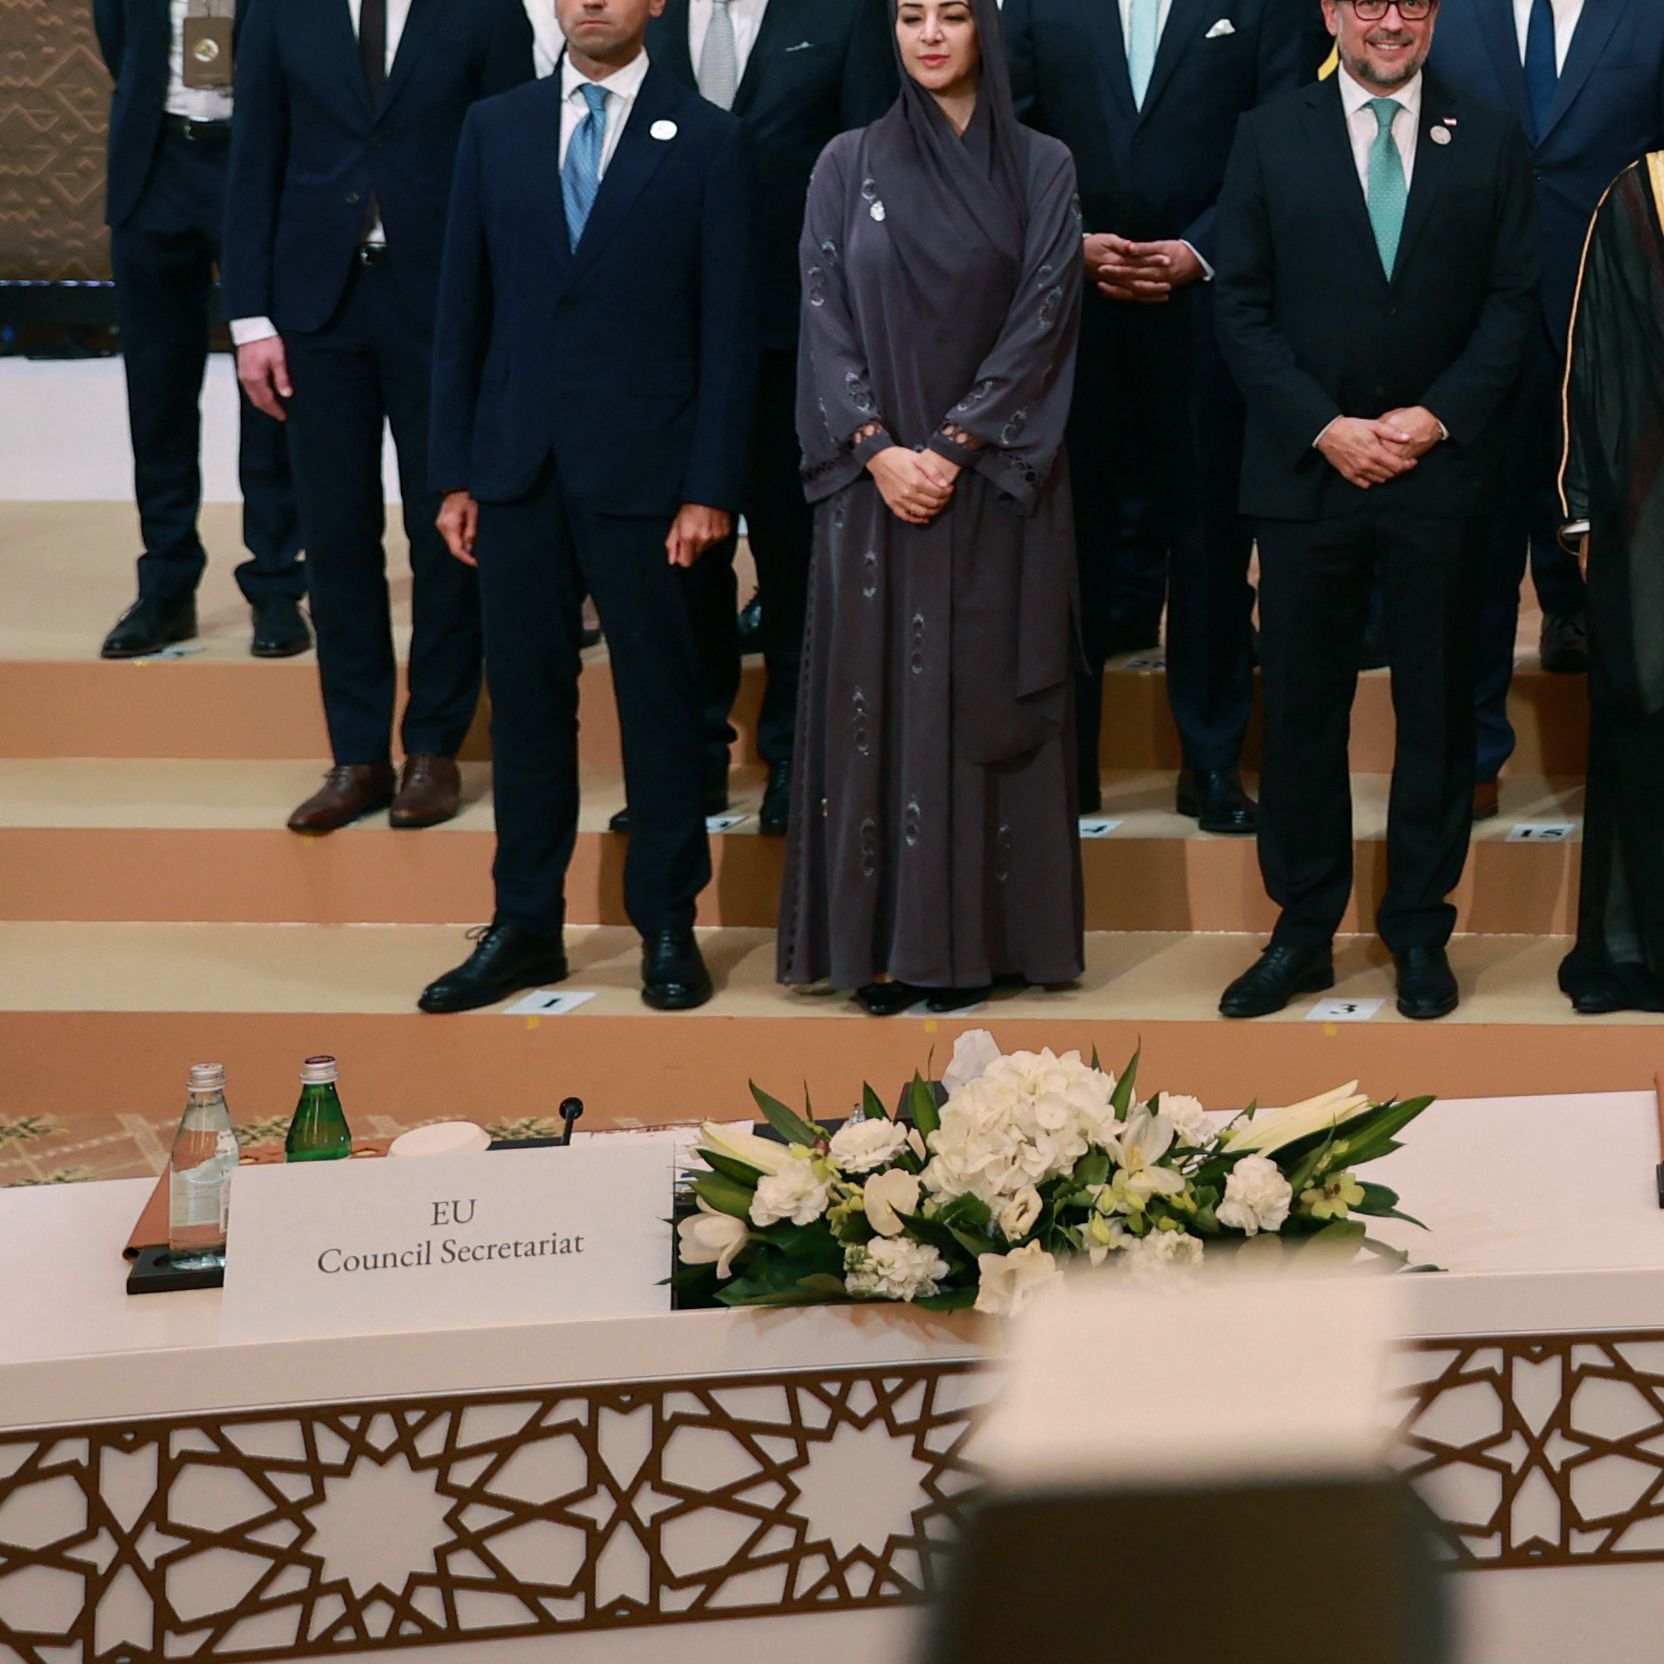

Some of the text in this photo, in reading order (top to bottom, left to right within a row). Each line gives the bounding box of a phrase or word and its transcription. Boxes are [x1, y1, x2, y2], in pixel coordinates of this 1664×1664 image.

[431, 1199, 476, 1226] EU
[317, 1232, 585, 1274] Council Secretariat
